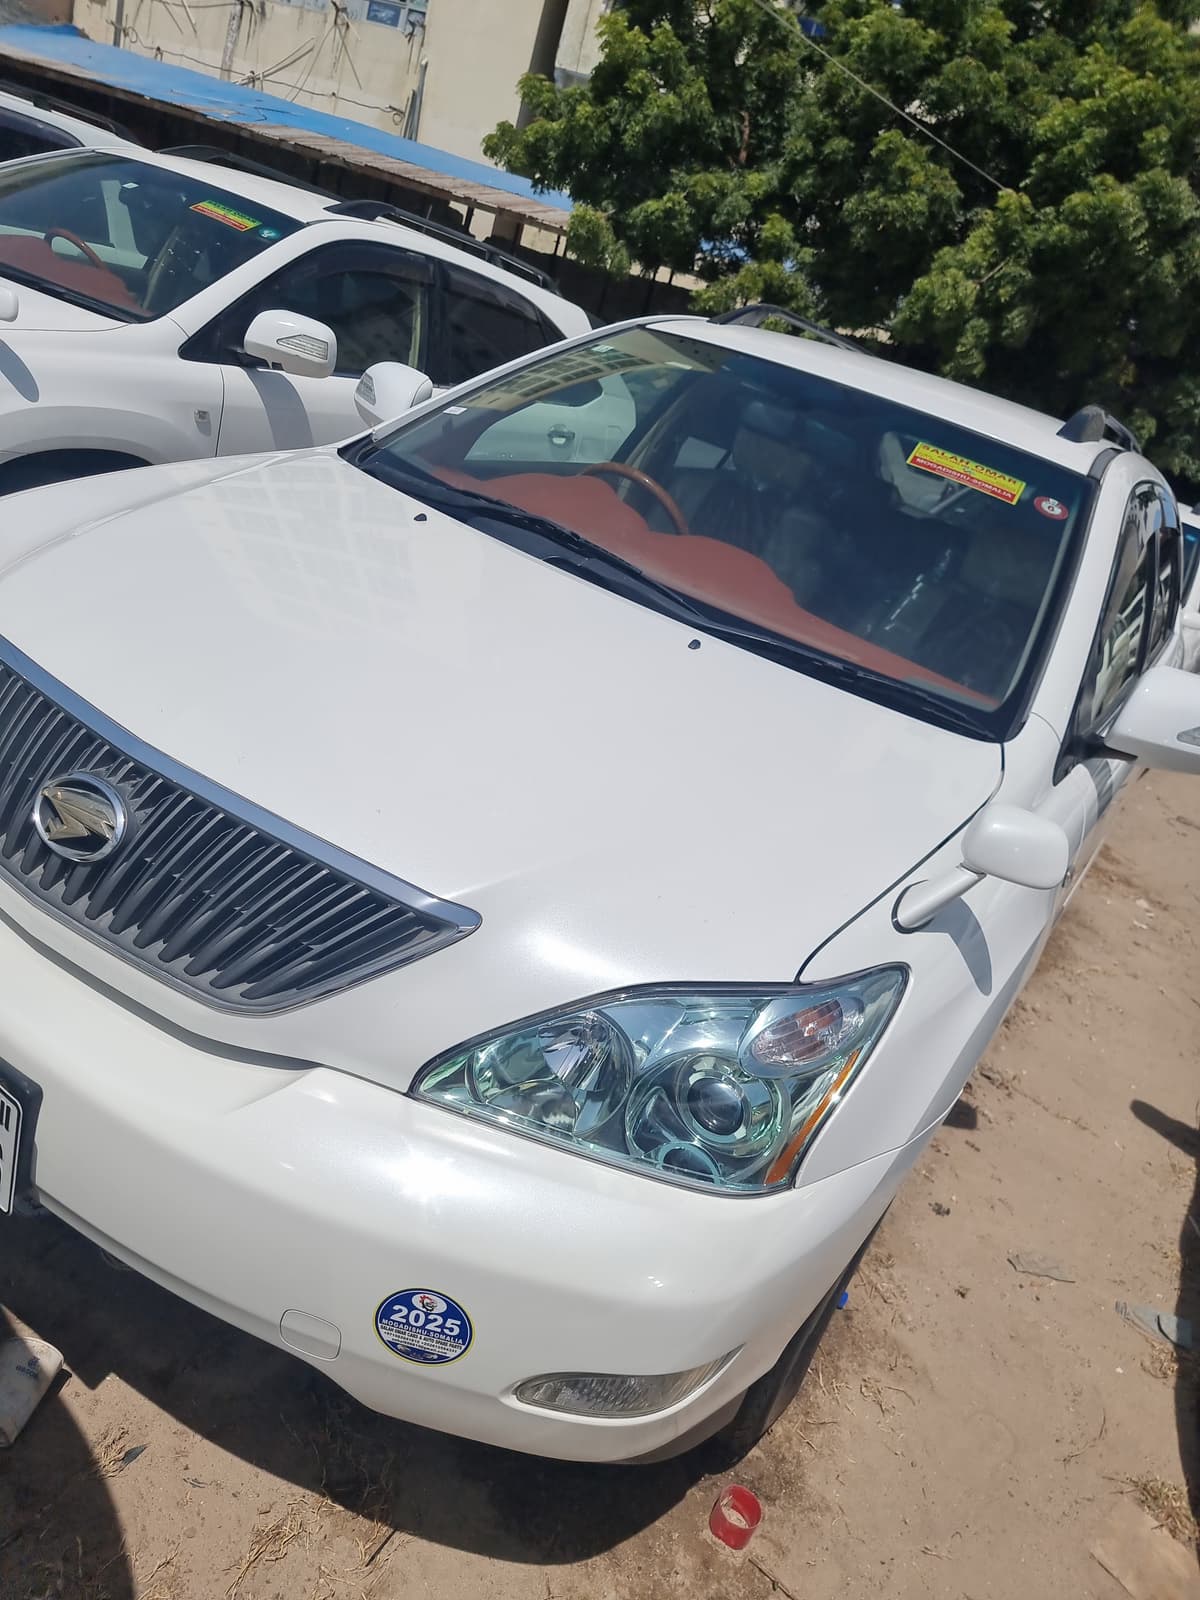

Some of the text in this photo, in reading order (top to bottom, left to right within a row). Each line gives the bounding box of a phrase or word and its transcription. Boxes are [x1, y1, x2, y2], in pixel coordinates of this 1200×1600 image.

[922, 445, 969, 466] SALAH
[975, 464, 1017, 484] OMAR
[382, 1318, 463, 1344] MOGADISHU-SOMALIA
[390, 1305, 461, 1335] 2025
